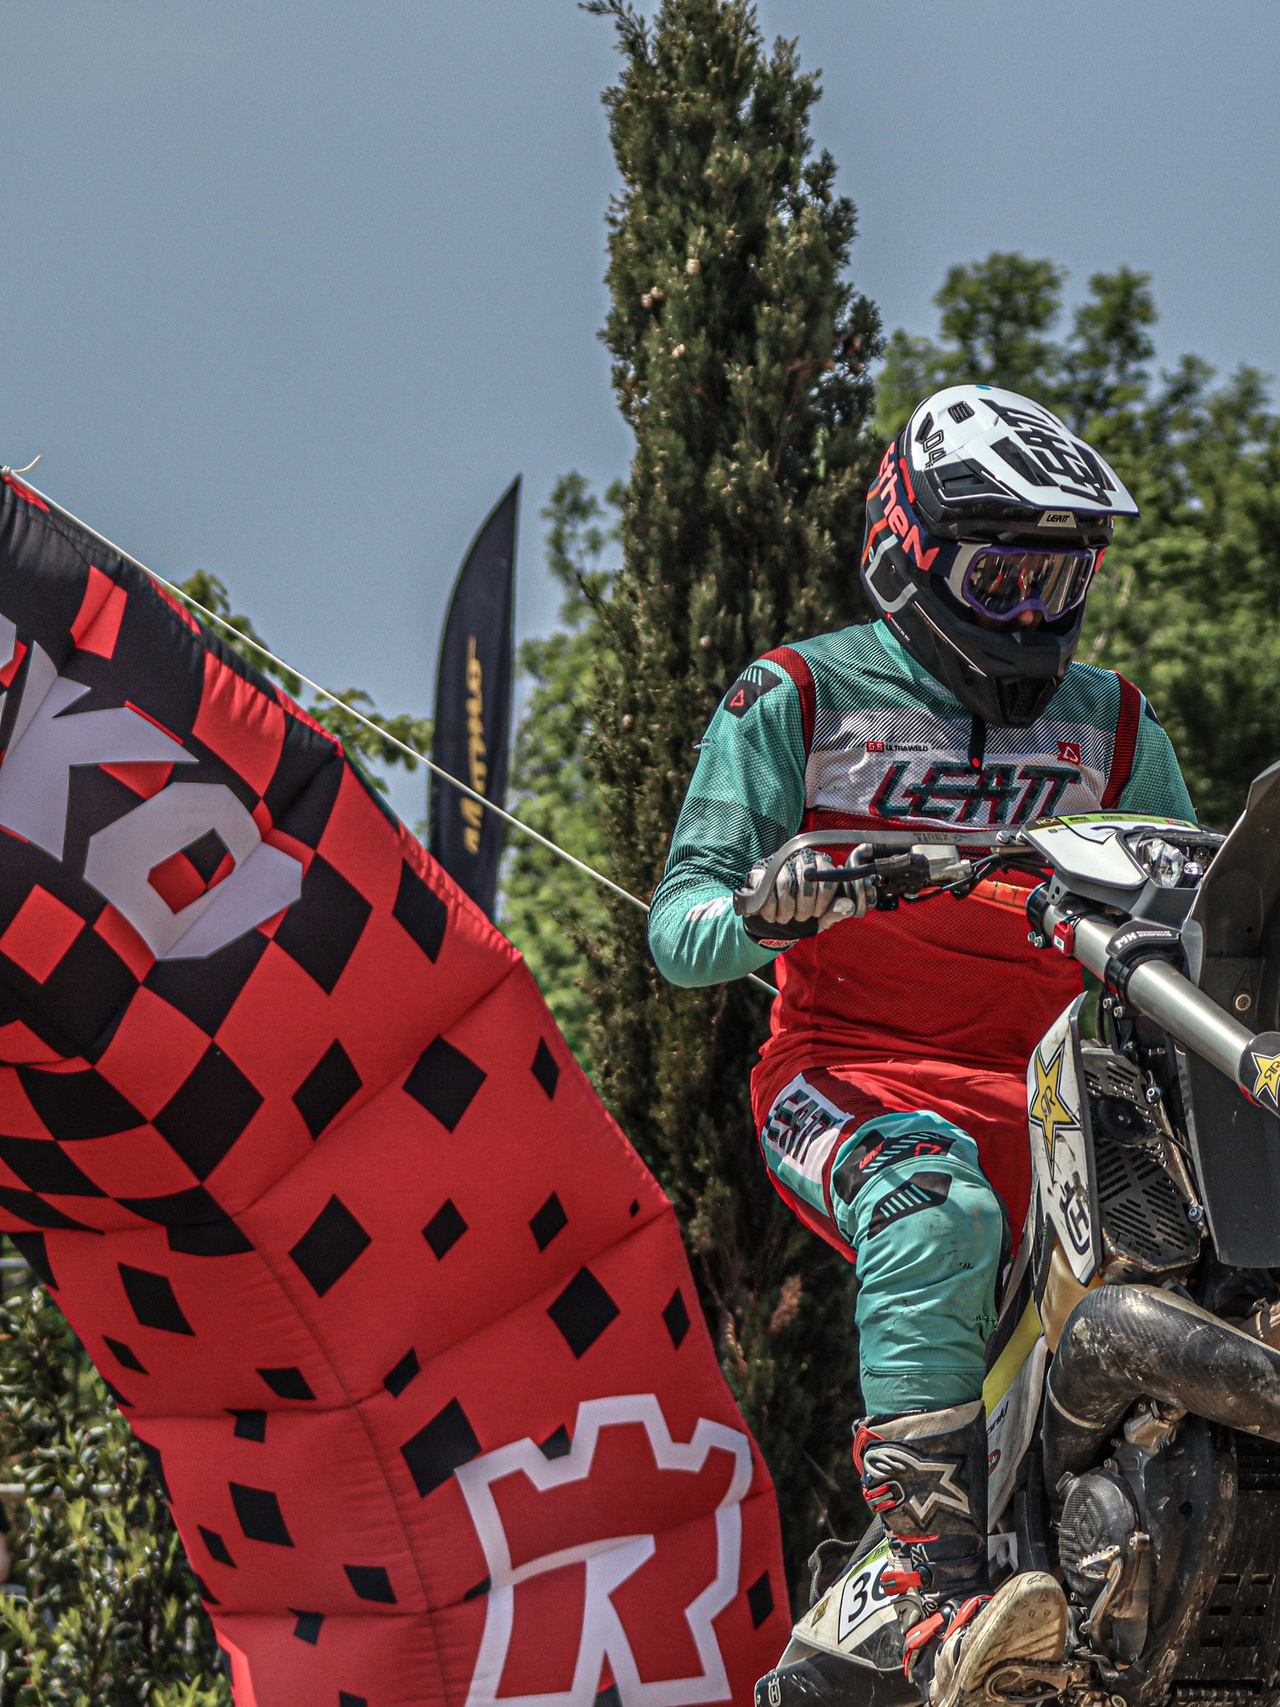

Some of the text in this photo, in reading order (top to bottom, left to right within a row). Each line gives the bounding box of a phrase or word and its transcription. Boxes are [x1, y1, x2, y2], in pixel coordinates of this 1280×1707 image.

[1045, 513, 1071, 524] LEATT
[0, 612, 303, 961] KO
[868, 760, 1082, 825] LEATT
